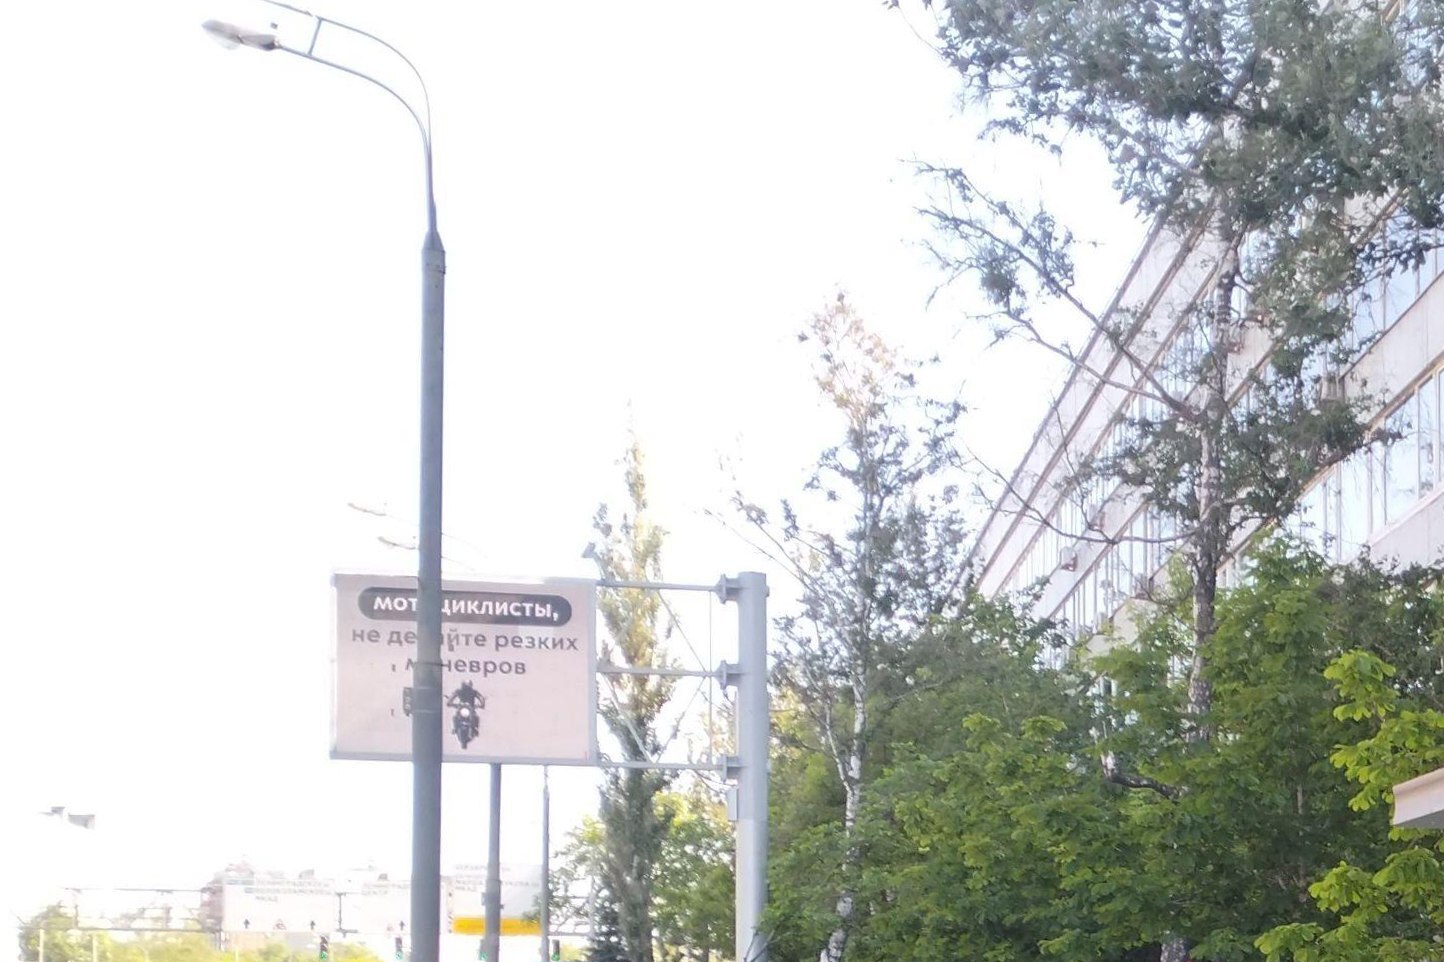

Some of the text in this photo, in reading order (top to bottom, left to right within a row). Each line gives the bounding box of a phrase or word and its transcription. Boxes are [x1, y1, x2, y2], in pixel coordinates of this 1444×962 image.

[352, 628, 579, 653] не дейте резких
